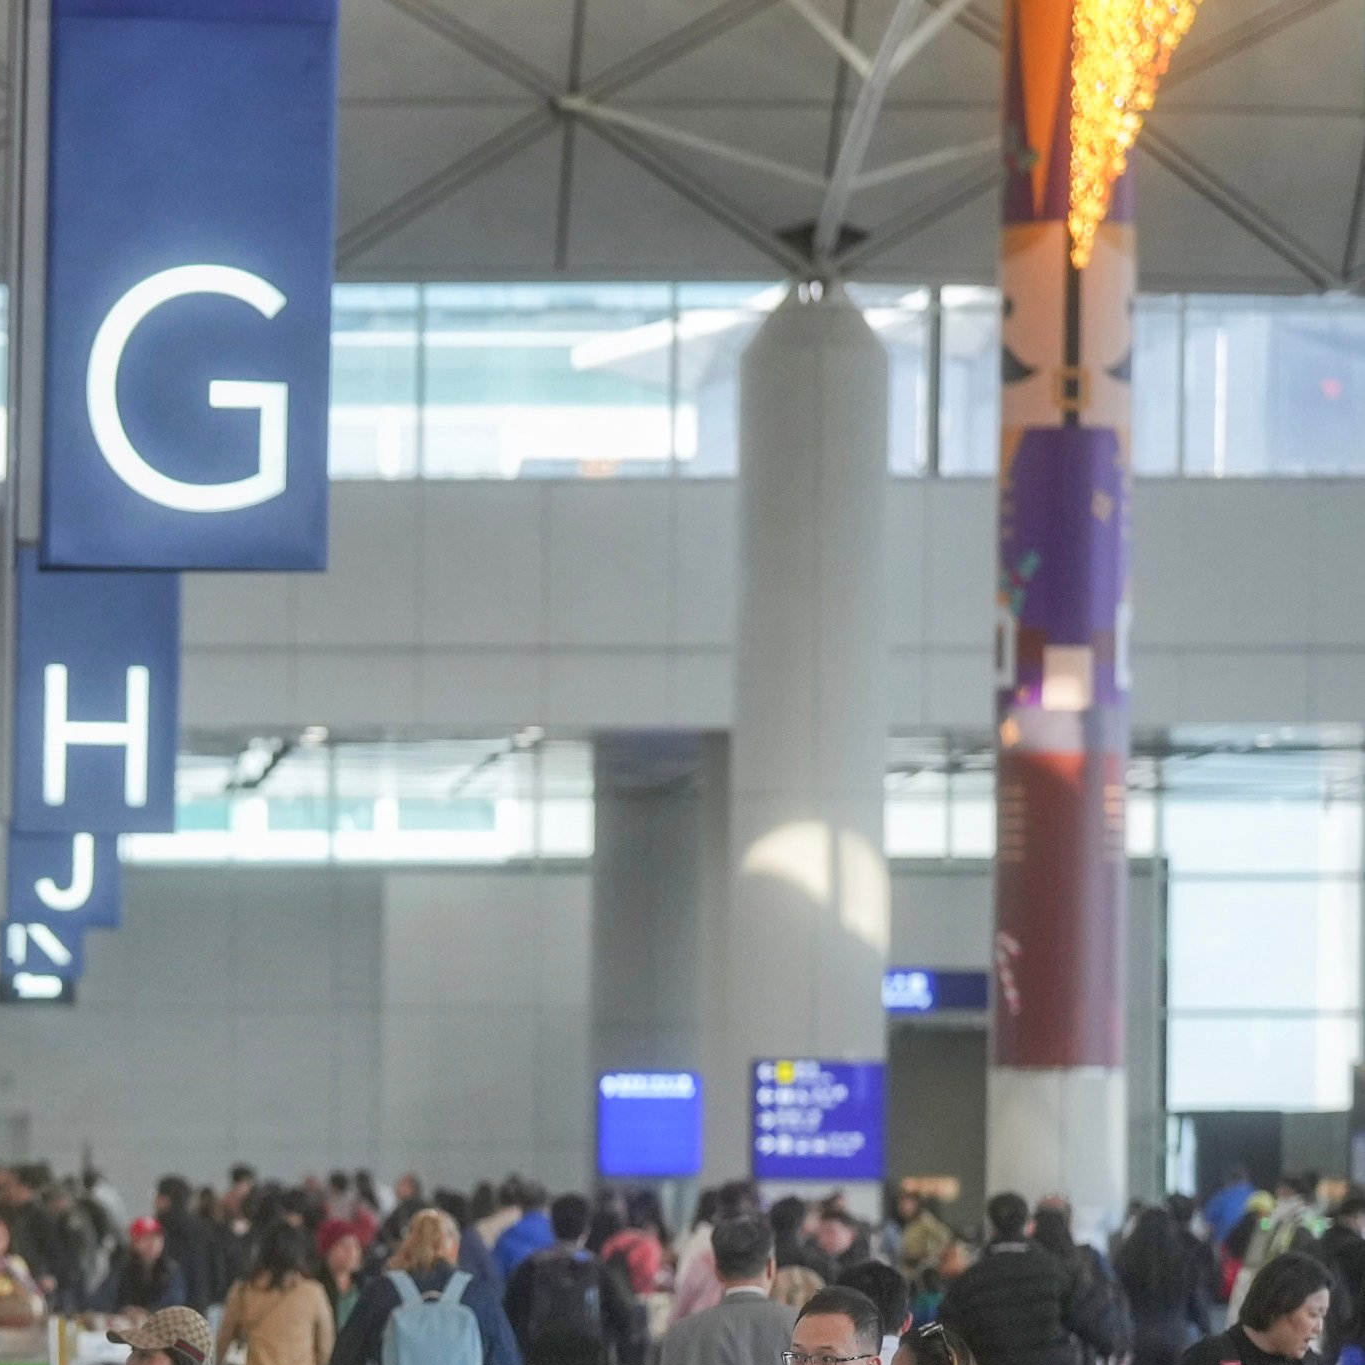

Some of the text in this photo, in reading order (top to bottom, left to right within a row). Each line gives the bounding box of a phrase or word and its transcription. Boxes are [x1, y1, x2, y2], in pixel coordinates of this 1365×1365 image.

[86, 263, 288, 513] G
[43, 662, 150, 808] H
[34, 831, 95, 912] J
